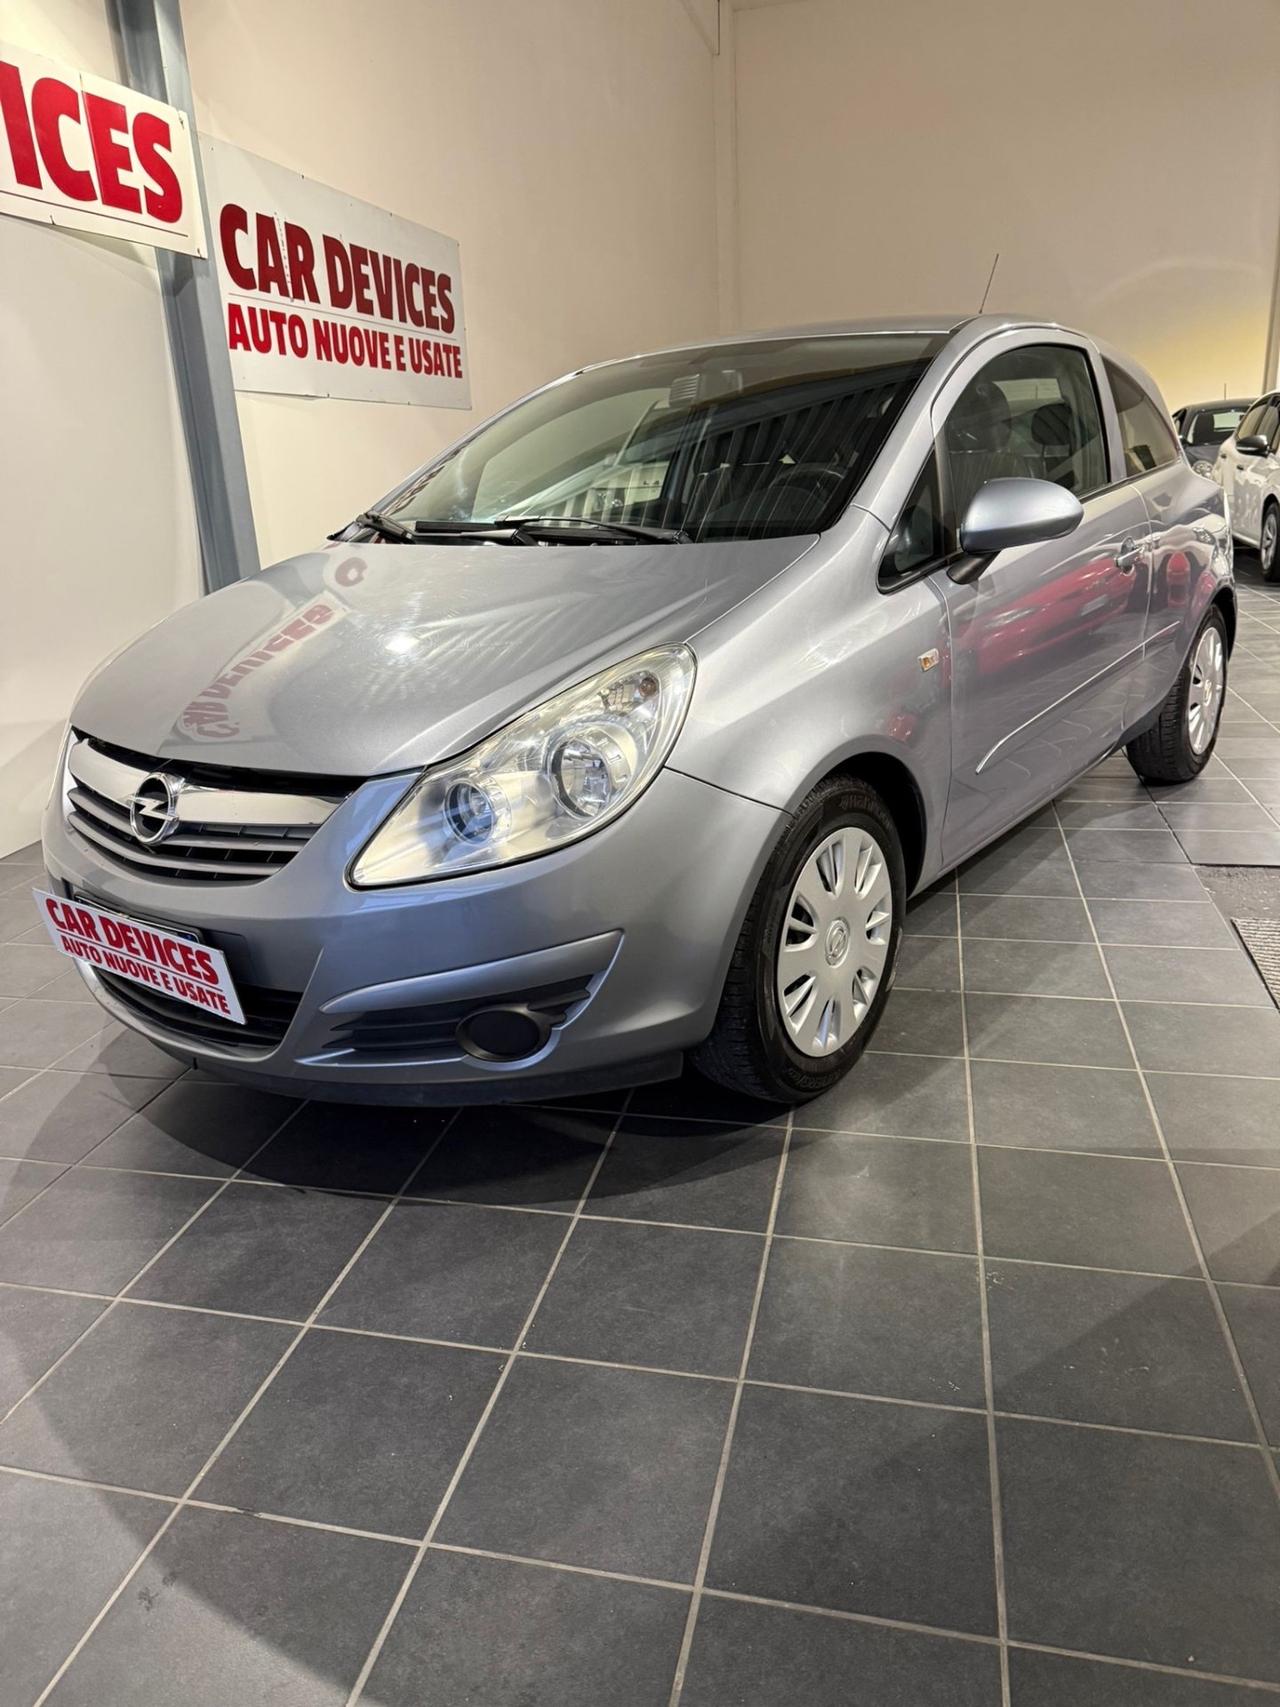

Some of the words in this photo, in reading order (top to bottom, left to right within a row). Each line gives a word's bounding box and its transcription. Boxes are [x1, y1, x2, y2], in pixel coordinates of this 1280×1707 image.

[0, 60, 184, 224] ICES
[219, 203, 320, 304] CAR
[323, 234, 456, 334] DEVICES
[227, 303, 308, 359] AUTO
[312, 319, 391, 370] NUOVE
[394, 336, 406, 373] E
[408, 338, 463, 379] USATE
[46, 898, 101, 942] CAR
[99, 915, 219, 986] DEVICES
[60, 936, 102, 964] AUTO
[105, 951, 161, 987] NUOVE
[160, 973, 173, 992] E
[173, 977, 231, 1015] USATE
